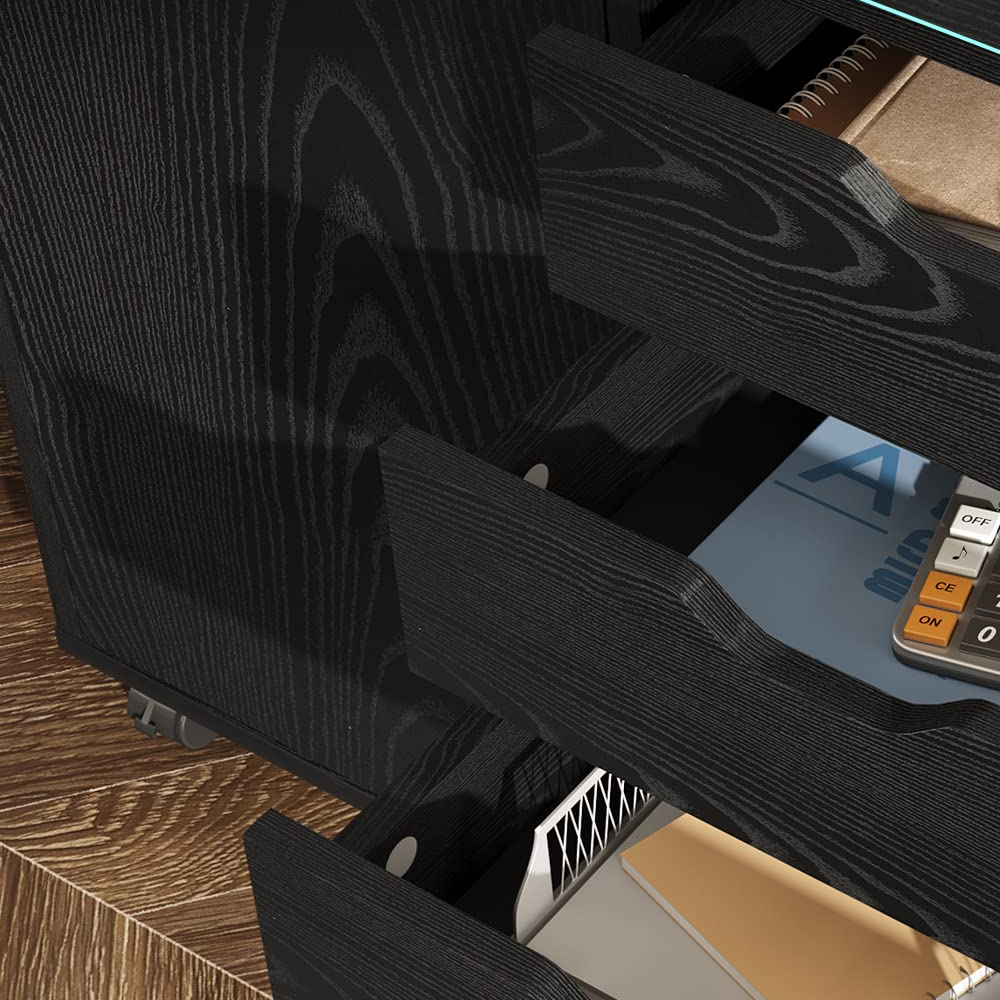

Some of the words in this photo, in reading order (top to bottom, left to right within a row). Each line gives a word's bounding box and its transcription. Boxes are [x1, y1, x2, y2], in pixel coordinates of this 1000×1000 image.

[961, 513, 992, 527] OFF
[935, 580, 957, 594] CE
[918, 615, 942, 628] ON
[977, 625, 997, 643] 0
